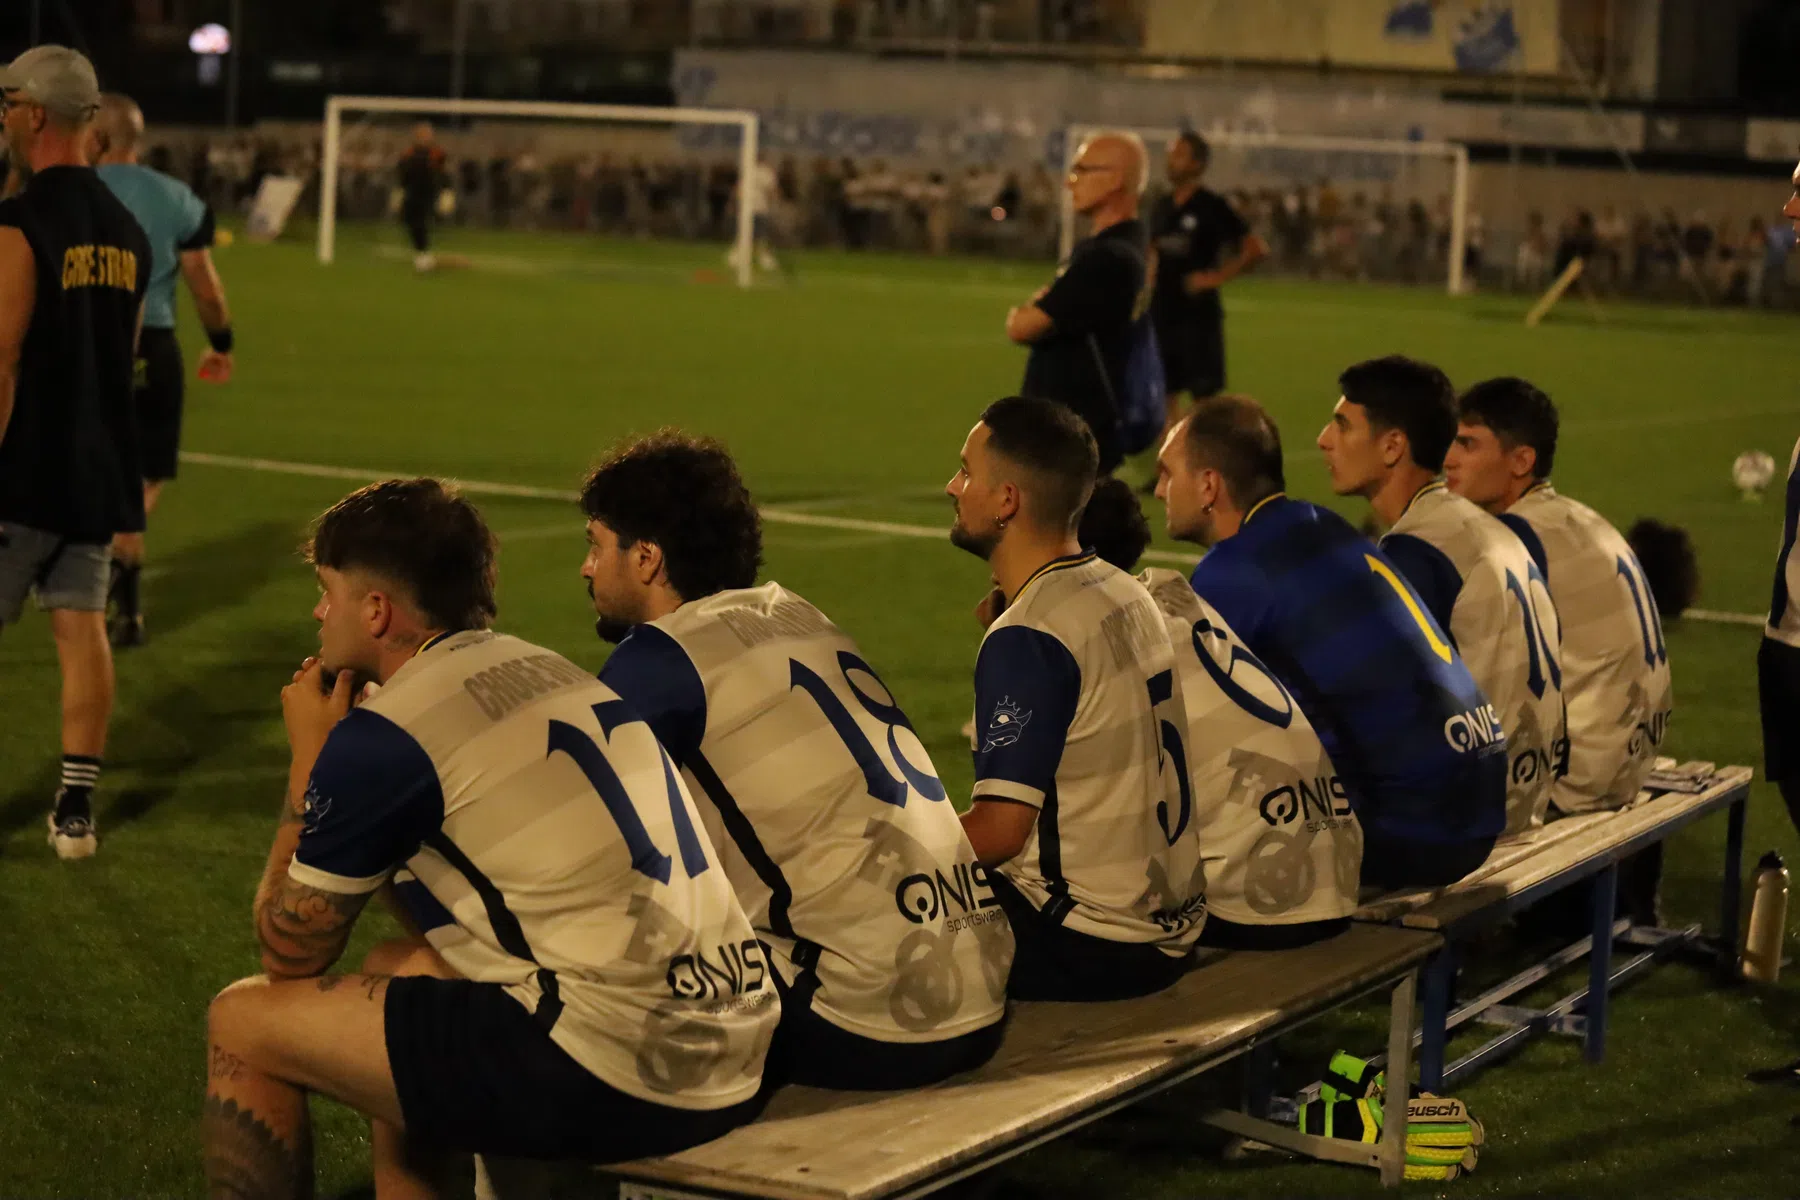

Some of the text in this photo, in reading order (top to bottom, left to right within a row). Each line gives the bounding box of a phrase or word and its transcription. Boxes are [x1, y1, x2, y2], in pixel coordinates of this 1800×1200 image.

[1364, 553, 1453, 666] 1
[1505, 560, 1562, 700] 10
[788, 650, 945, 808] 18
[1192, 618, 1293, 729] 6
[546, 699, 709, 886] 17
[1146, 668, 1190, 847] 5
[1259, 776, 1352, 826] ONIS
[896, 860, 999, 924] ONIS
[946, 908, 1004, 935] sportswea
[666, 939, 765, 999] ONIS
[1408, 1101, 1460, 1117] eusch
